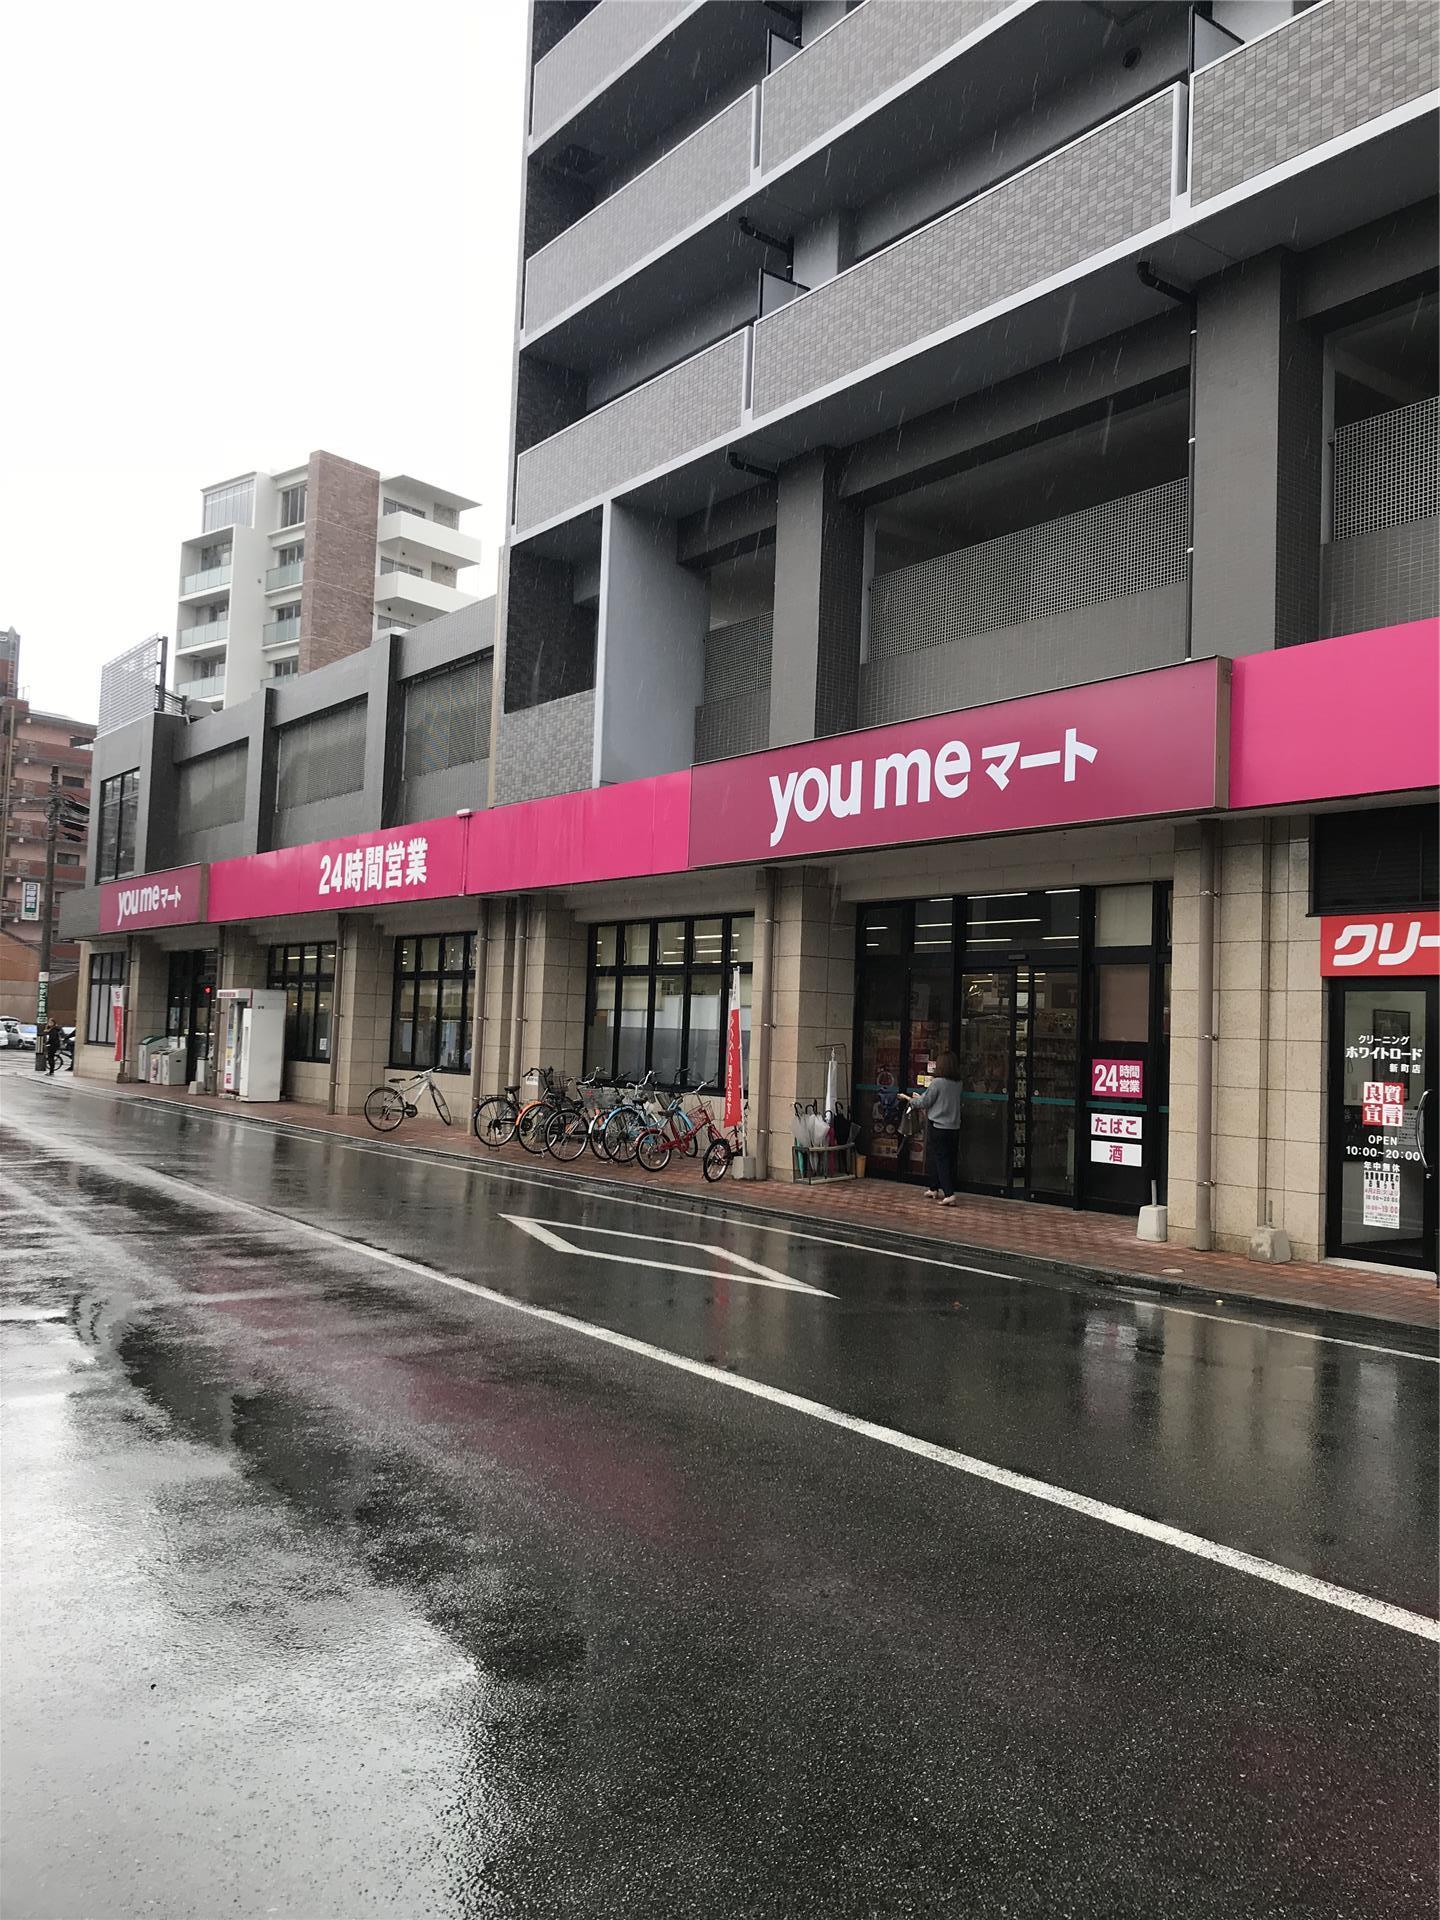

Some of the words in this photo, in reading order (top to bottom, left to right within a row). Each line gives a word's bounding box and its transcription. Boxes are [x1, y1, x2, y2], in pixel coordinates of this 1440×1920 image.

[981, 728, 1098, 791] マート
[319, 837, 428, 895] 24時間営業
[160, 885, 182, 908] マート
[1358, 1035, 1410, 1046] クリーニング
[1345, 1046, 1423, 1061] ホワイトロード
[1389, 1063, 1421, 1074] 新町店
[1094, 1116, 1138, 1136] たばこ
[1368, 1134, 1398, 1146] OPEN
[1108, 1145, 1123, 1163] 酒
[1363, 1161, 1401, 1172] 年中無休
